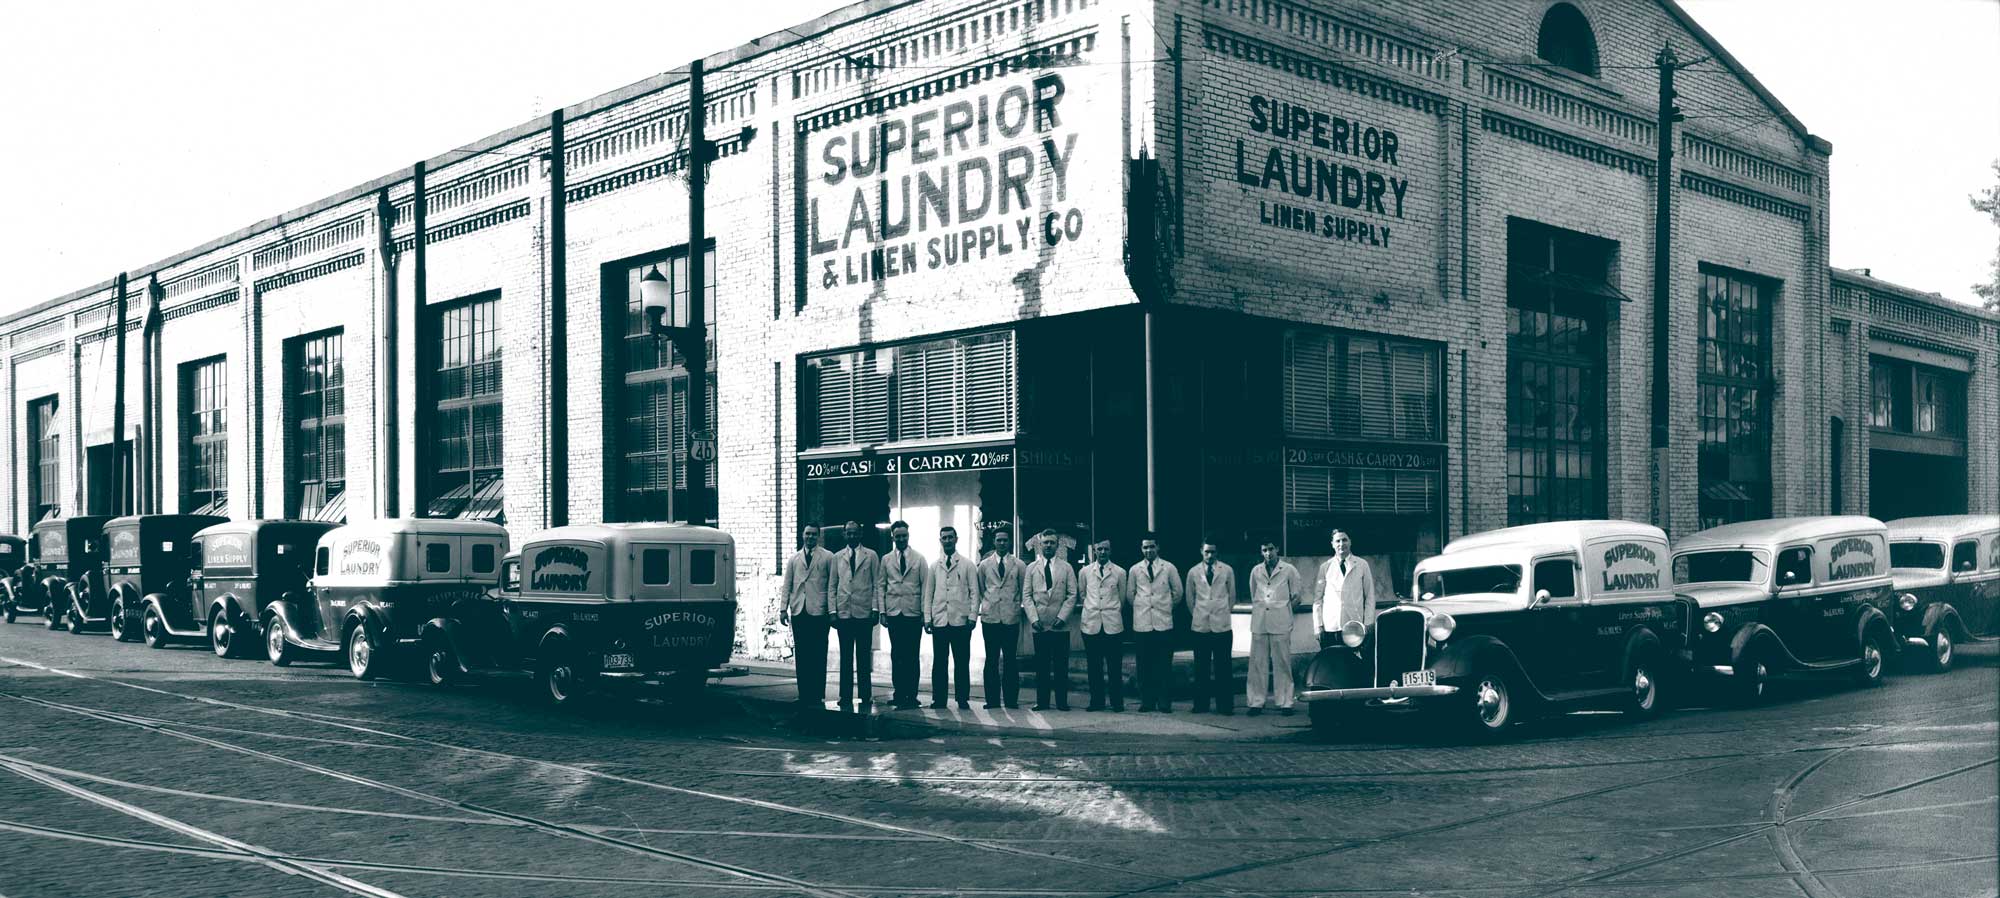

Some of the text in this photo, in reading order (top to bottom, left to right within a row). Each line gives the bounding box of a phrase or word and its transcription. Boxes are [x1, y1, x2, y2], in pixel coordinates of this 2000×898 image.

[822, 74, 1065, 185] SUPERIOR
[1250, 95, 1399, 166] SUPERIOR
[1237, 139, 1408, 219] LAUNDRY
[810, 133, 1079, 256] LAUNDRY
[1260, 201, 1390, 248] LINEN SUPPLY
[822, 207, 1083, 289] & LINEN SUPPLY CO
[840, 460, 875, 475] CASH
[886, 459, 896, 472] &
[909, 454, 965, 471] CARRY
[1327, 451, 1354, 465] CASH
[1355, 452, 1364, 465] &
[1366, 452, 1404, 468] CARRY
[343, 539, 381, 558] SUPERIOR
[535, 546, 589, 572] SUPERIOR
[1604, 543, 1656, 568] SUPERIOR
[1830, 537, 1874, 563] SUPERIOR
[340, 559, 382, 576] LAUNDRY
[1829, 558, 1877, 580] LAUNDRY
[531, 570, 592, 591] LAUNDRY
[1602, 569, 1660, 591] LAUNDRY
[644, 612, 716, 630] SUPERIOR
[653, 633, 712, 648] LAUNDRY
